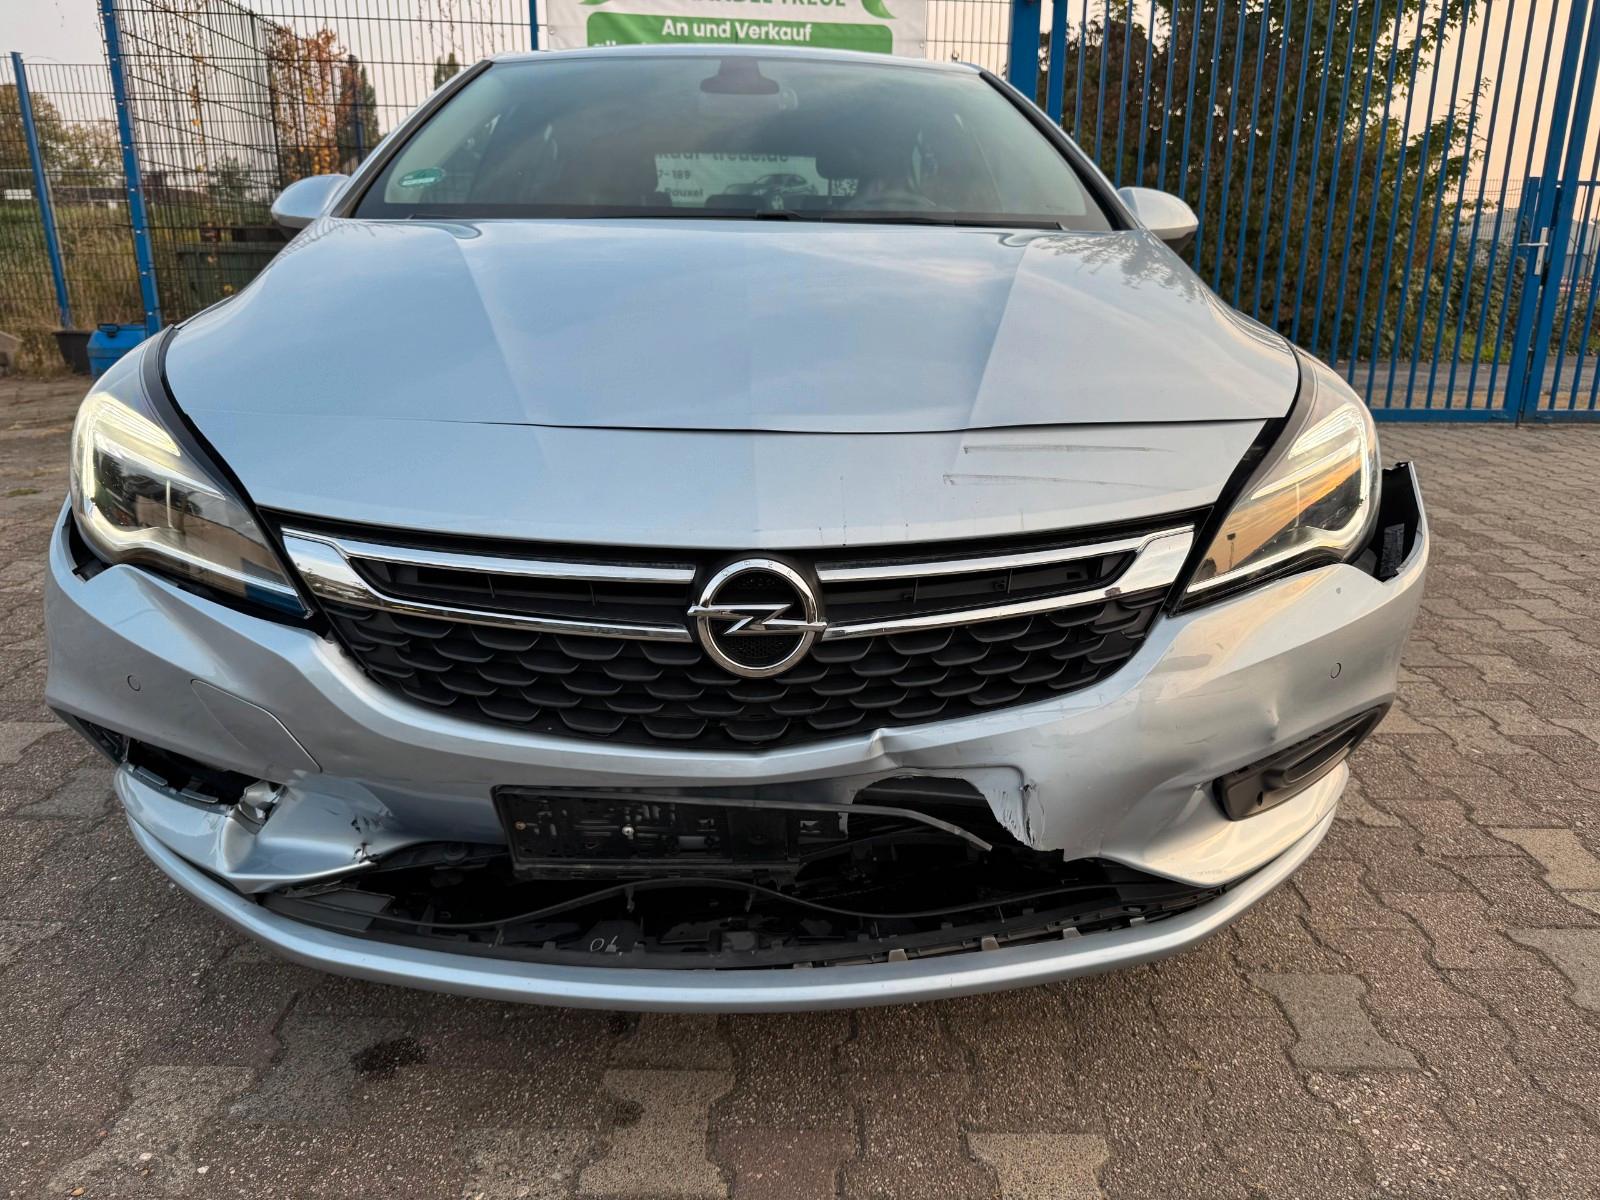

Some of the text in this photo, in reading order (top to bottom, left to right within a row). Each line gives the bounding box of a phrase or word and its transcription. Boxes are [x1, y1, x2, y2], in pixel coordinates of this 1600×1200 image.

[662, 18, 812, 41] An und Verkauf
